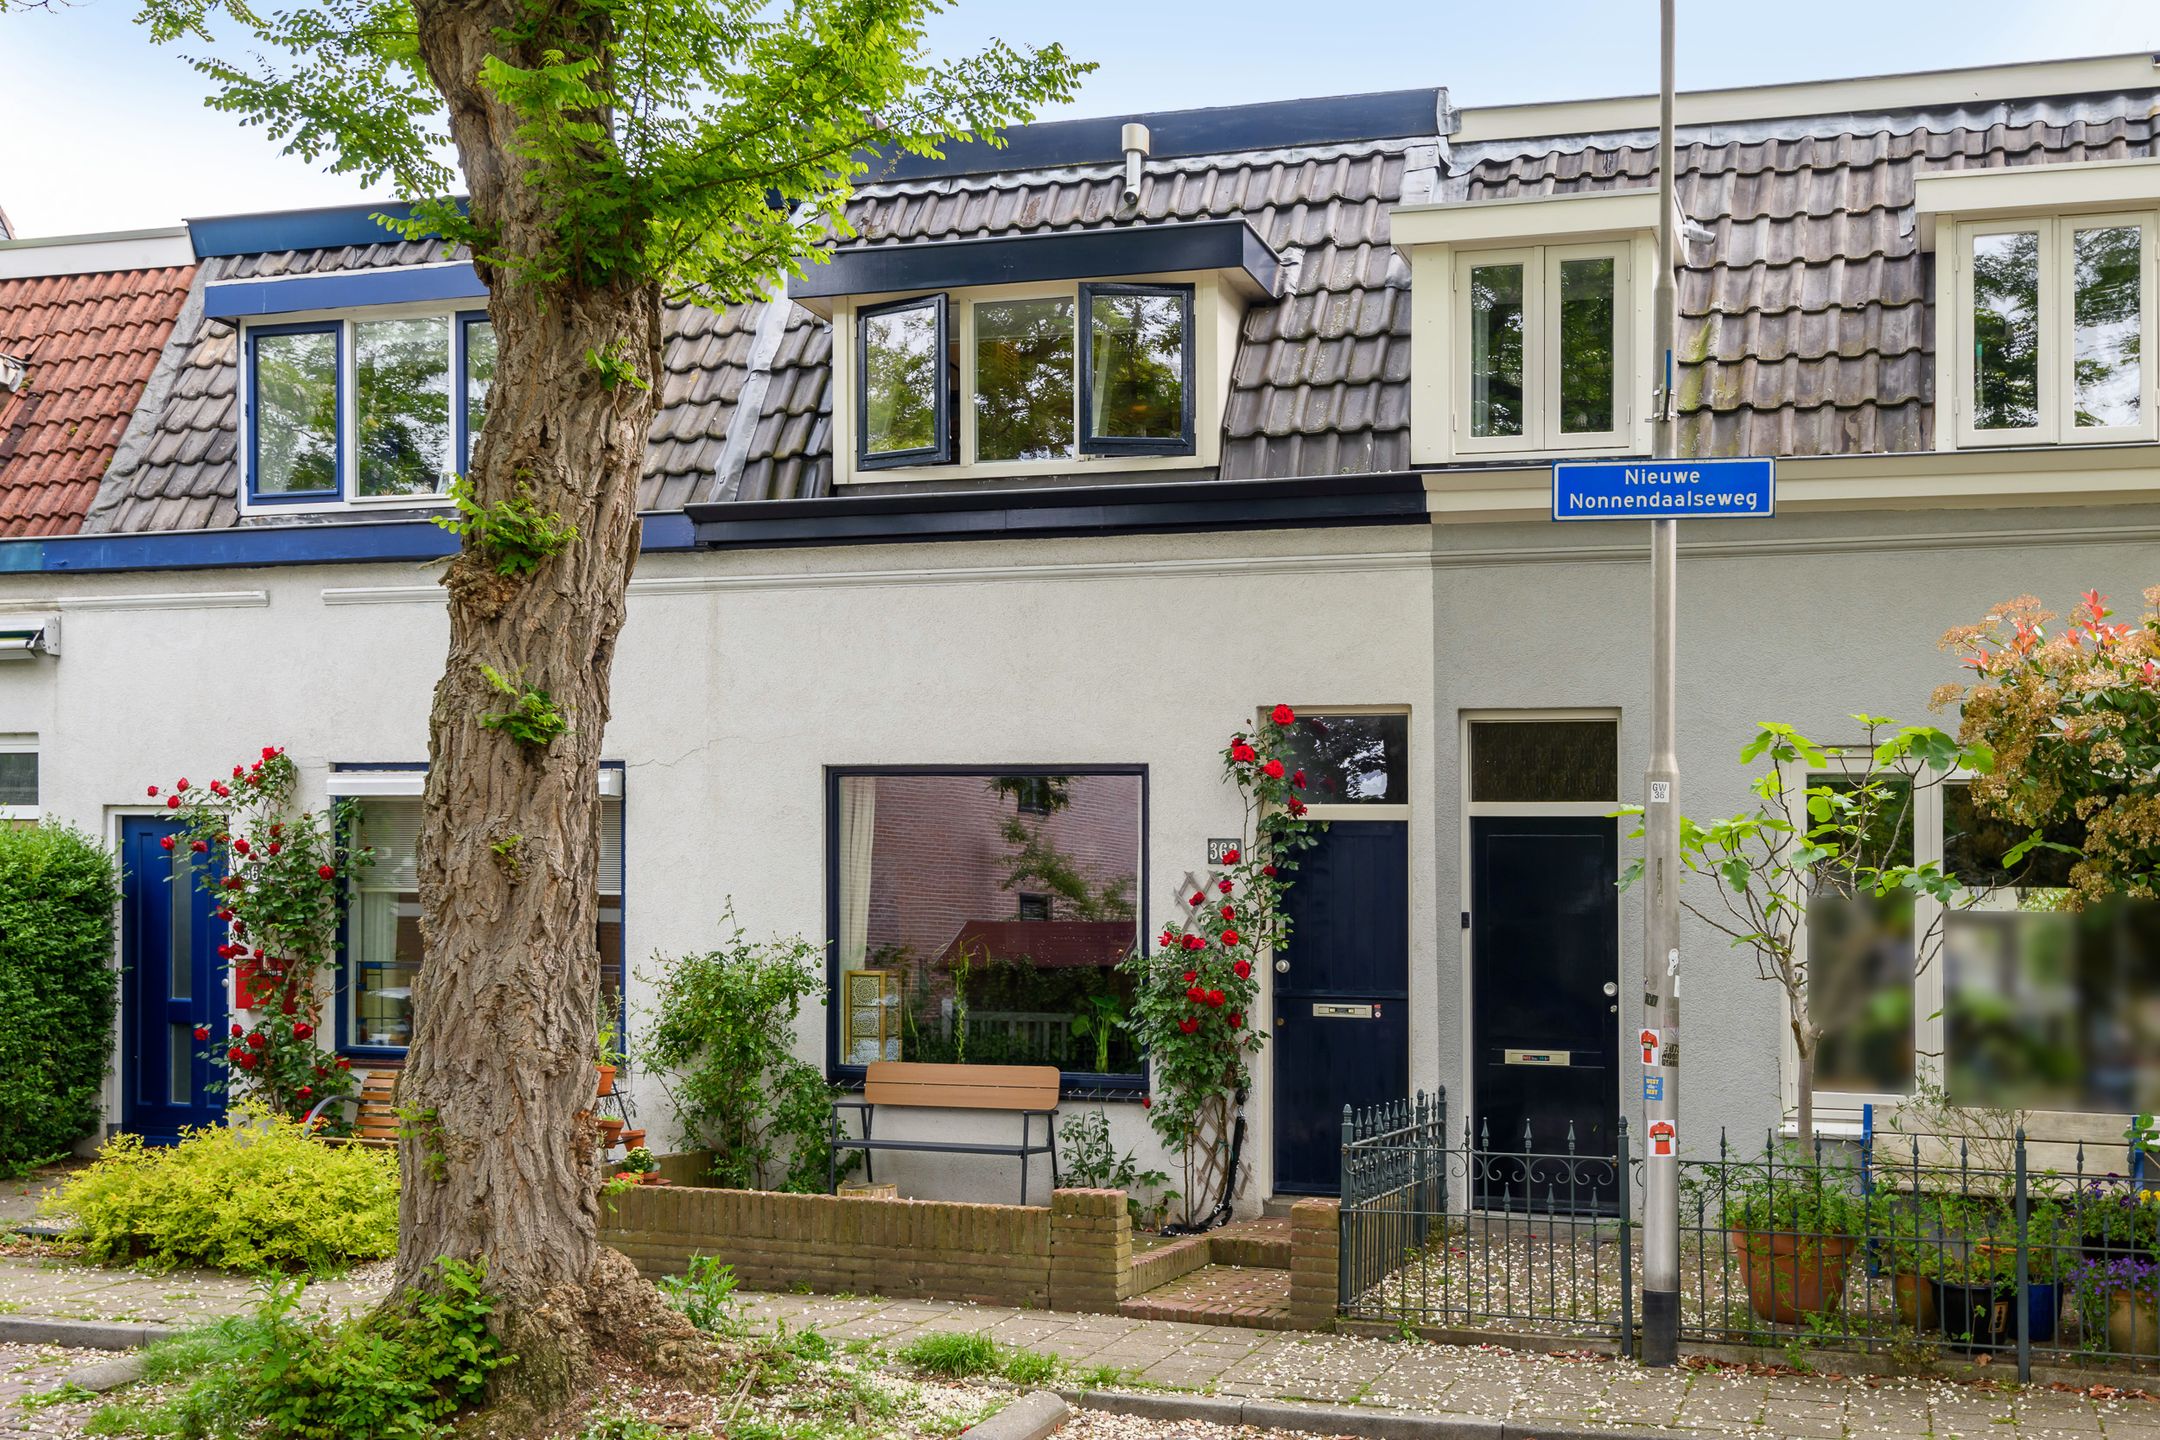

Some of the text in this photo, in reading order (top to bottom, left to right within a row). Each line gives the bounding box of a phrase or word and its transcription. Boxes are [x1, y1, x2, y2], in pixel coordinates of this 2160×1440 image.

[1625, 469, 1700, 485] Nieuwe
[1569, 490, 1757, 510] Nonnendaalseweg
[1652, 783, 1666, 791] GW
